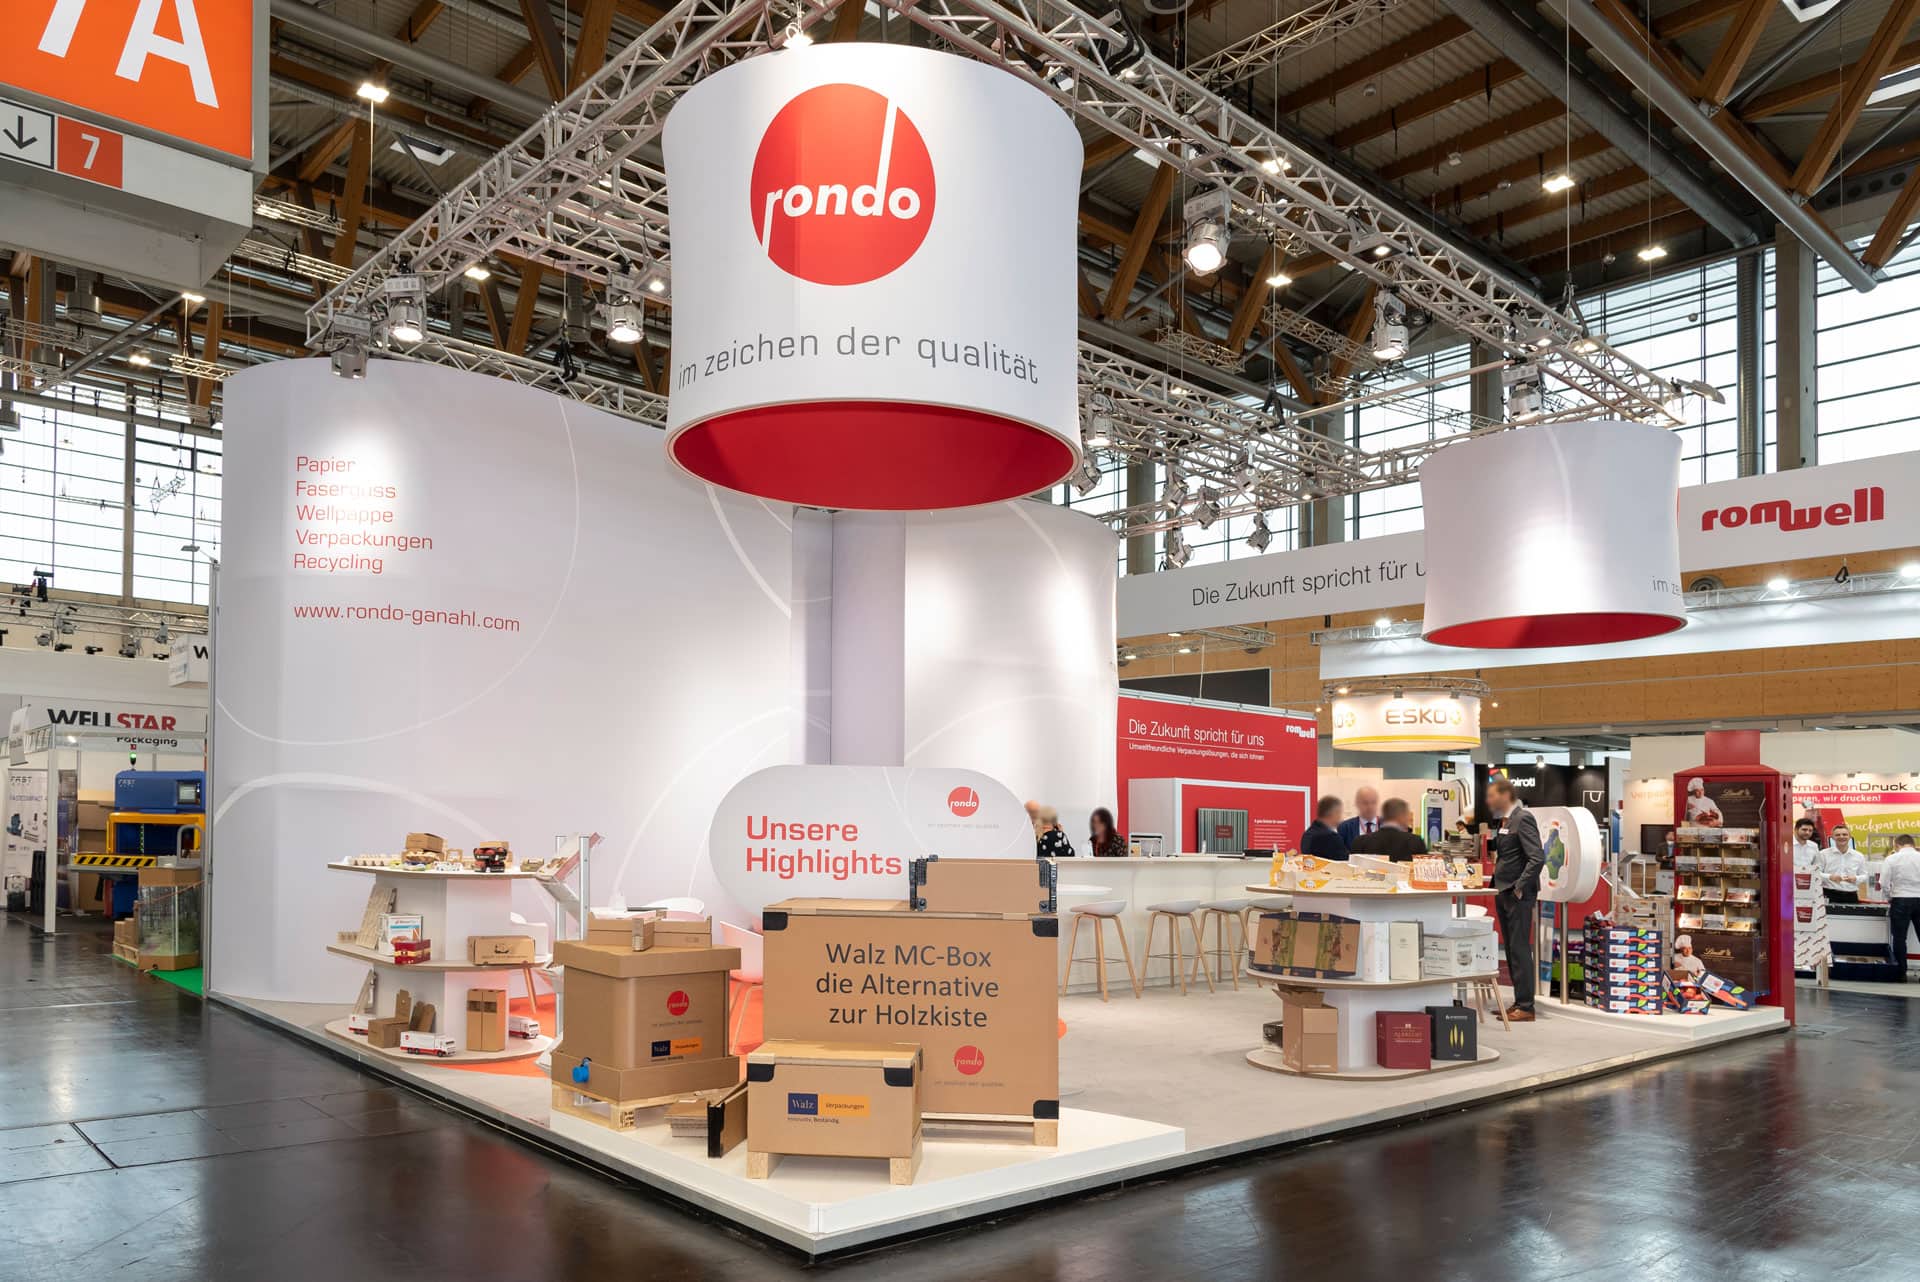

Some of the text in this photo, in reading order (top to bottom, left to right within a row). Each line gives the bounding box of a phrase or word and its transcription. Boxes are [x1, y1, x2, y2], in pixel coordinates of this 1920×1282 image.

[81, 133, 100, 170] 7
[678, 327, 1039, 391] im zeichen der qualität
[296, 456, 356, 475] Papier
[296, 505, 394, 526] Wellpappe
[1701, 486, 1884, 532] romwell
[296, 529, 433, 552] Verpackungen
[294, 553, 383, 575] Recycling
[1192, 588, 1220, 607] Die
[1225, 575, 1296, 602] Zukunft
[1302, 565, 1371, 594] spricht
[1378, 560, 1408, 582] für
[1651, 575, 1669, 593] im
[294, 604, 521, 632] www.rondo-ganahl.com
[1385, 708, 1448, 724] ESKO
[1128, 719, 1265, 746] Die Zukunft spricht für uns
[1840, 794, 1881, 802] drucken!
[746, 815, 859, 842] Unsere
[746, 847, 902, 881] Highlights
[825, 943, 992, 968] Walz MC-Box
[816, 971, 999, 998] die Alternative
[828, 1004, 988, 1028] zur Holzkiste
[792, 1099, 815, 1109] Walz
